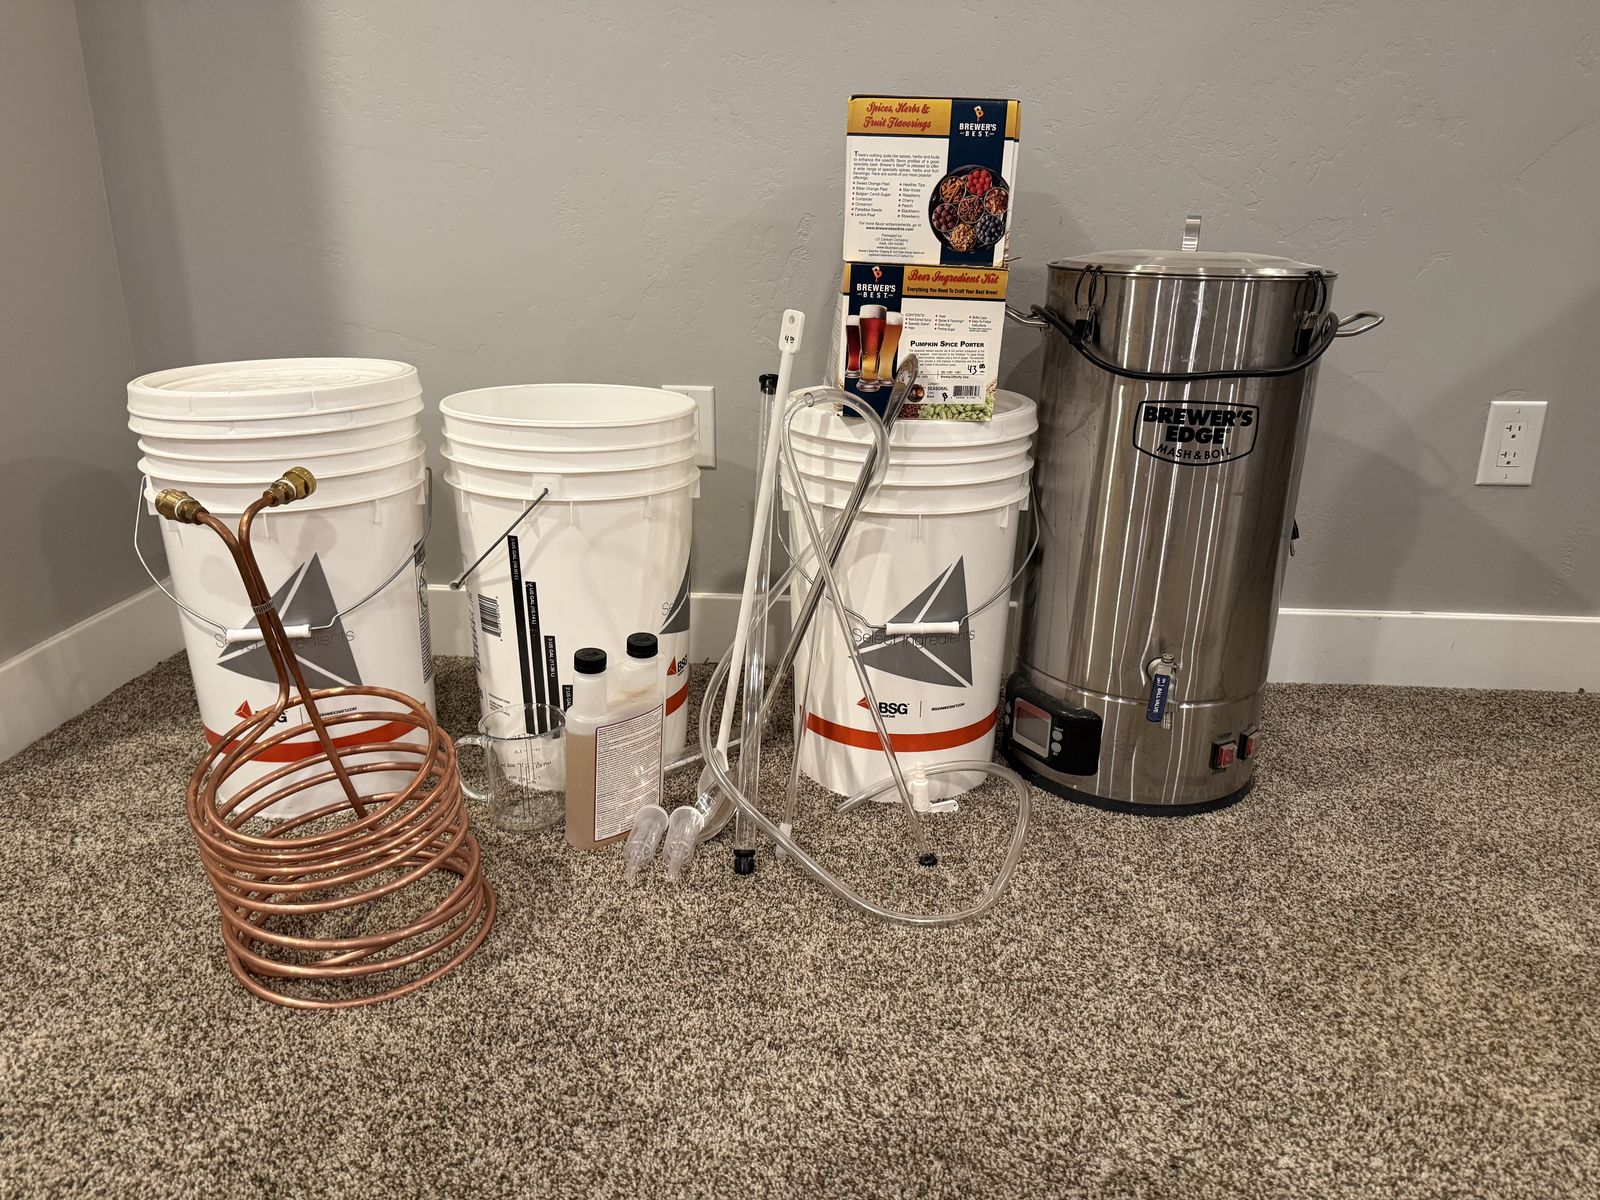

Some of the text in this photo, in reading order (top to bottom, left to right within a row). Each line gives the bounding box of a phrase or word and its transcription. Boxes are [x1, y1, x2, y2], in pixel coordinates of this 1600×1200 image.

[866, 102, 930, 115] Spices, Herbs &
[864, 116, 932, 131] Fruit Flavorings
[960, 123, 997, 131] BREWER'S
[908, 269, 999, 285] Beer Ingredient Kit
[857, 283, 896, 292] BREWER'S
[968, 365, 977, 375] 43
[1143, 406, 1253, 426] BREWER'S
[1165, 426, 1225, 444] EDGE
[1156, 444, 1231, 459] MASH & BOIL
[853, 628, 975, 649] Select Ingredients
[879, 702, 908, 714] BSG
